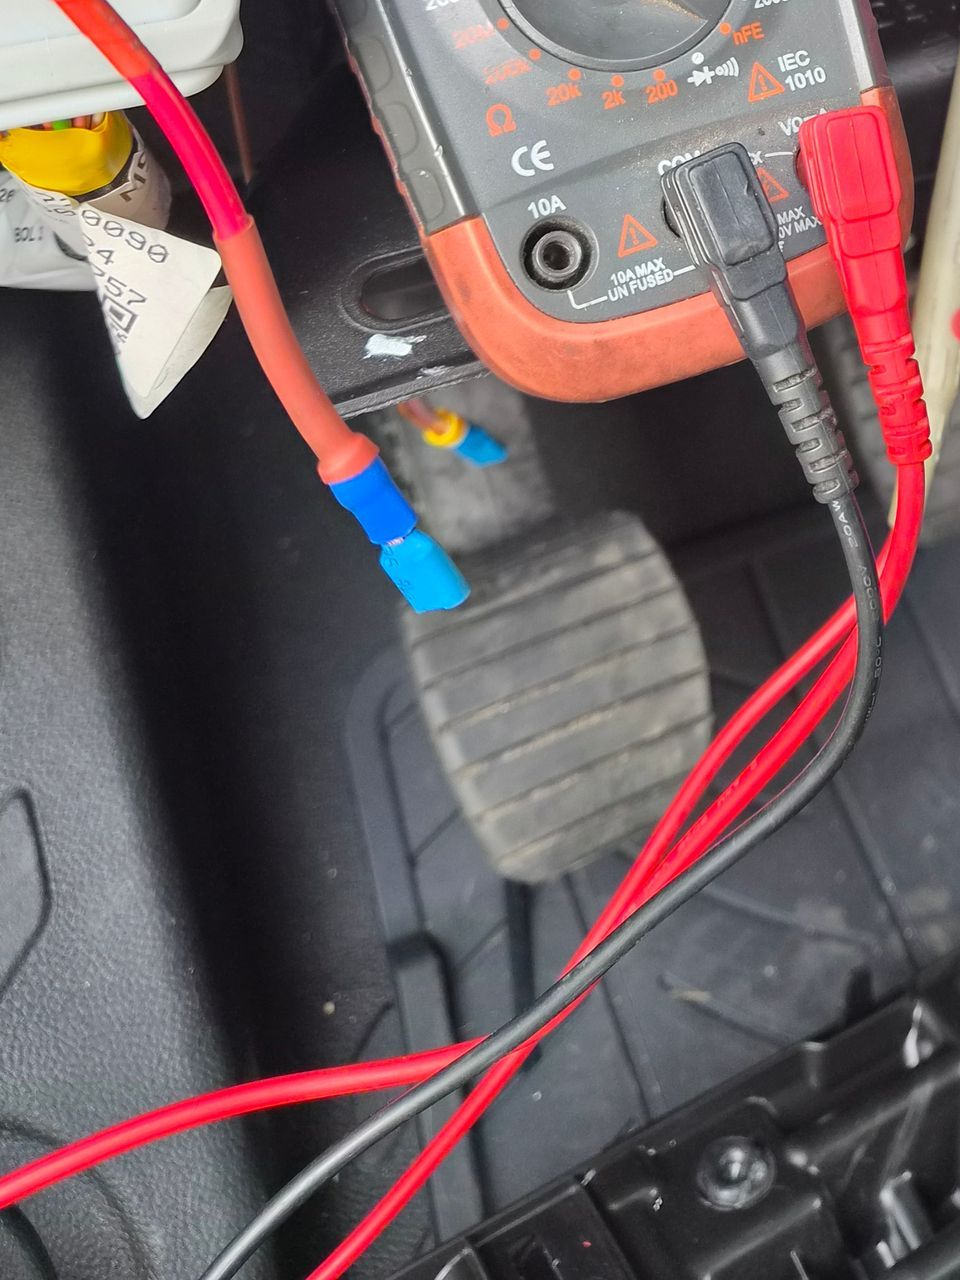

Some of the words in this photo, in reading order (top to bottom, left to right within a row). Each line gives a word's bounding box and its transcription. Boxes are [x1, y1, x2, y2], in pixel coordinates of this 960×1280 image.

[777, 50, 812, 72] IEC
[647, 79, 679, 103] 200
[784, 67, 827, 92] 1010
[510, 140, 555, 177] CE
[527, 194, 567, 219] 10A
[610, 268, 636, 286] 10A
[634, 257, 666, 278] MAX
[608, 284, 629, 302] UN
[628, 268, 674, 295] FUSED
